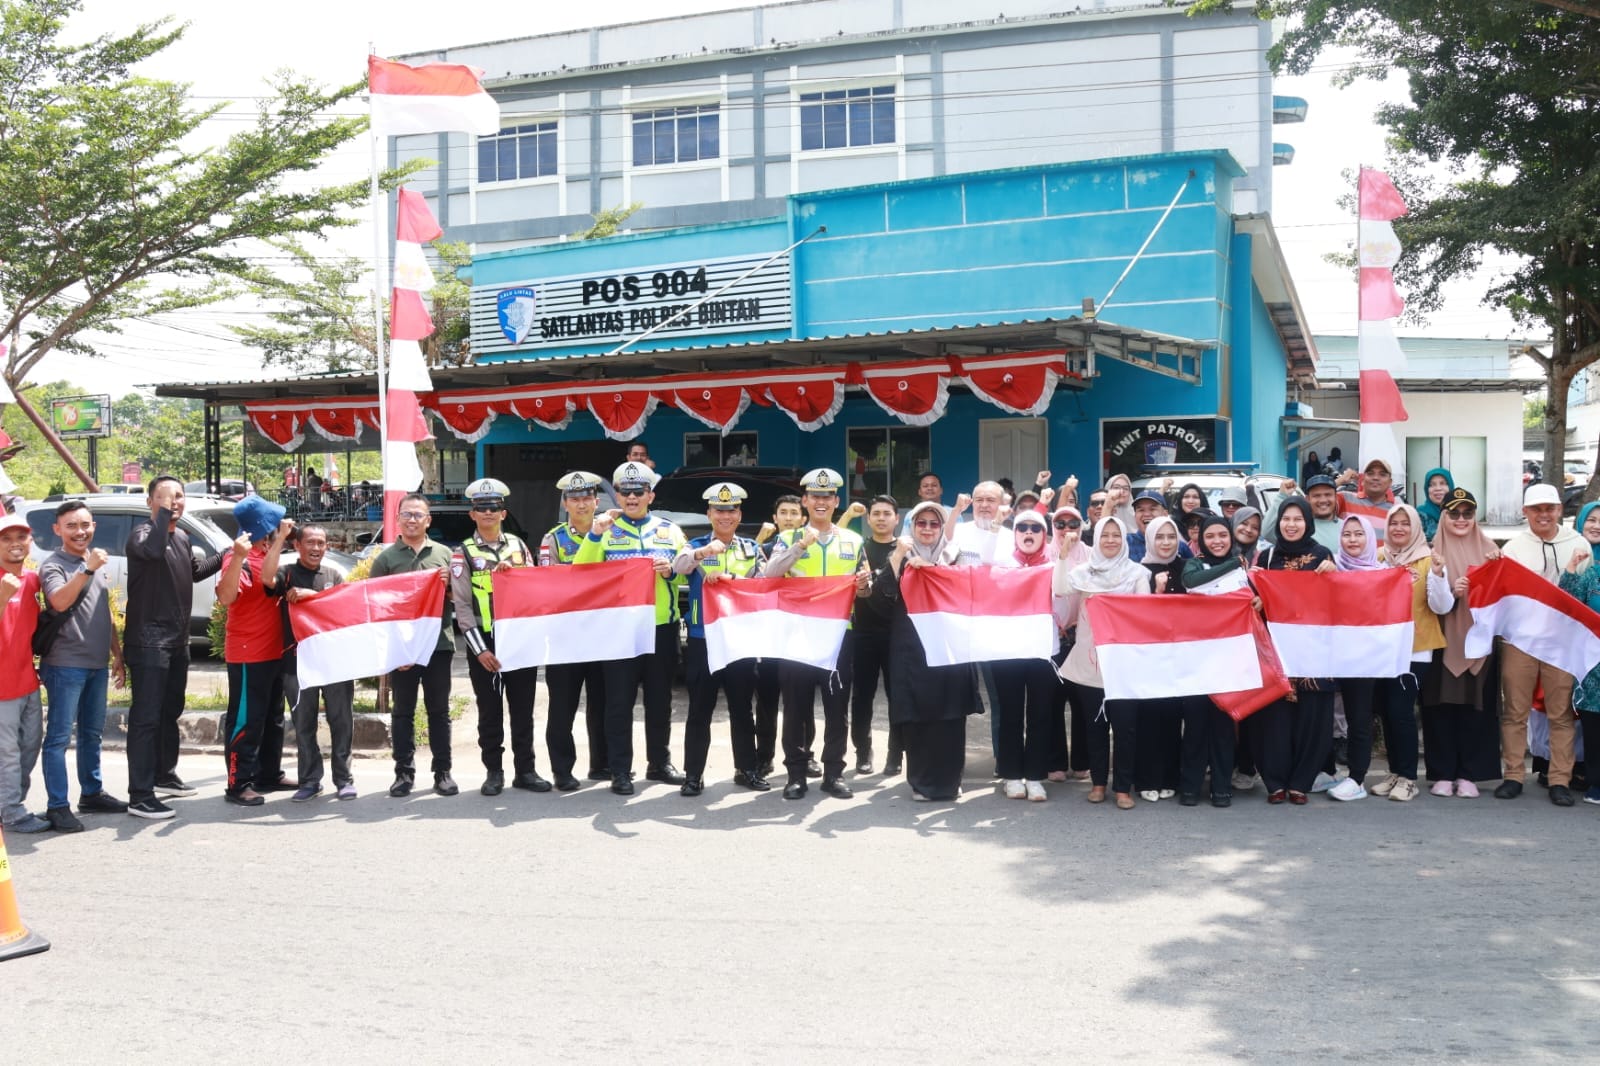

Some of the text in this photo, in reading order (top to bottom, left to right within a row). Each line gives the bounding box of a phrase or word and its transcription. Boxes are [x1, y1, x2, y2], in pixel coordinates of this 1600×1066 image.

[582, 266, 708, 305] POS 904
[540, 298, 760, 339] SATLANTAS POLRES BINTAN
[1112, 424, 1207, 456] UNIT PATROLI
